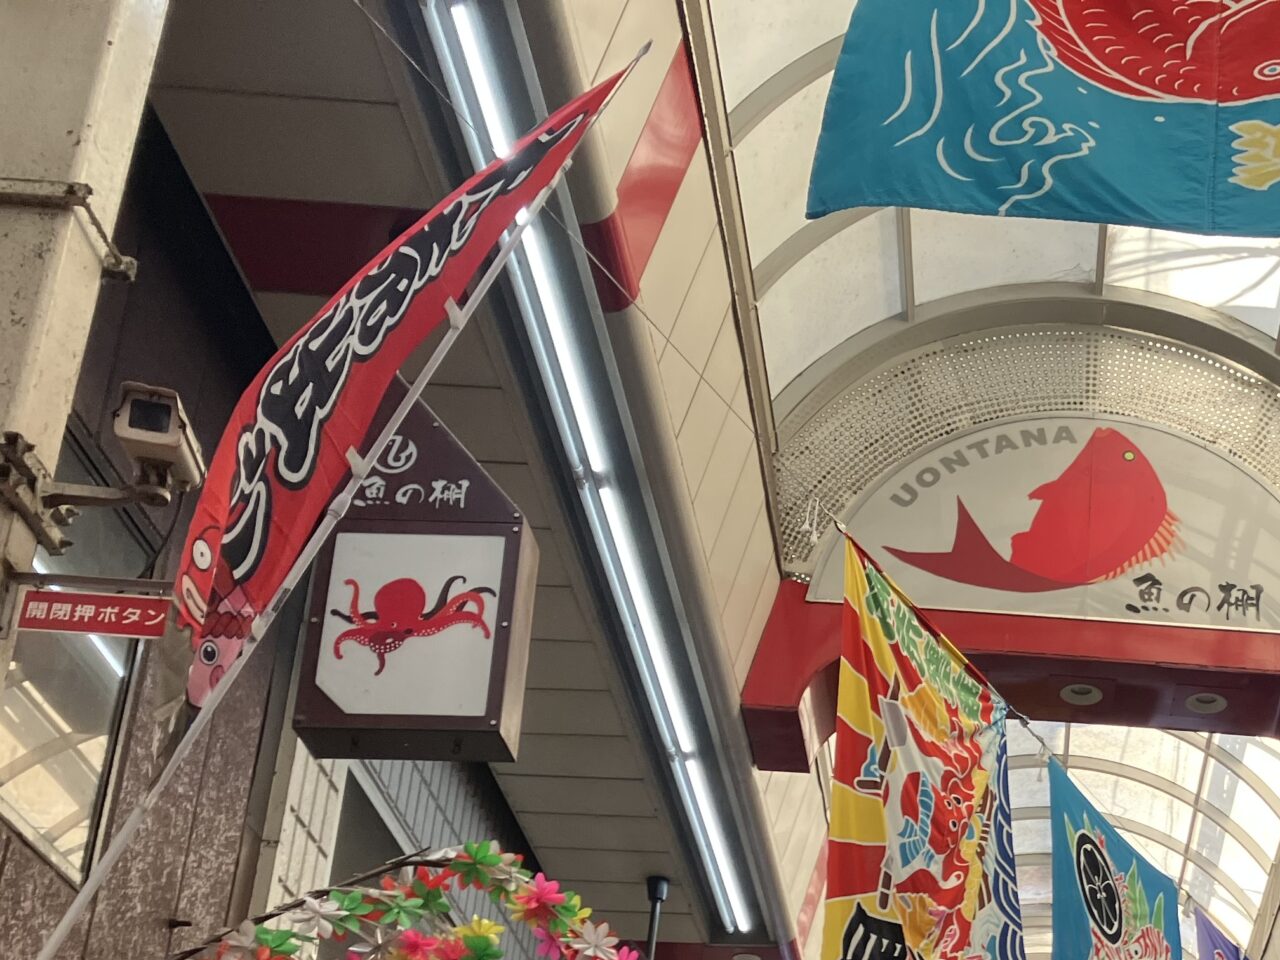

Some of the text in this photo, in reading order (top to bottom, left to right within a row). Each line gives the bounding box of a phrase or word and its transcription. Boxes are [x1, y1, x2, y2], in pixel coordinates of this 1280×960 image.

[890, 423, 1081, 512] UONTANA
[353, 478, 470, 509] 魚の棚
[25, 600, 166, 626] 開閉押ボタン
[1123, 572, 1264, 621] 魚の棚
